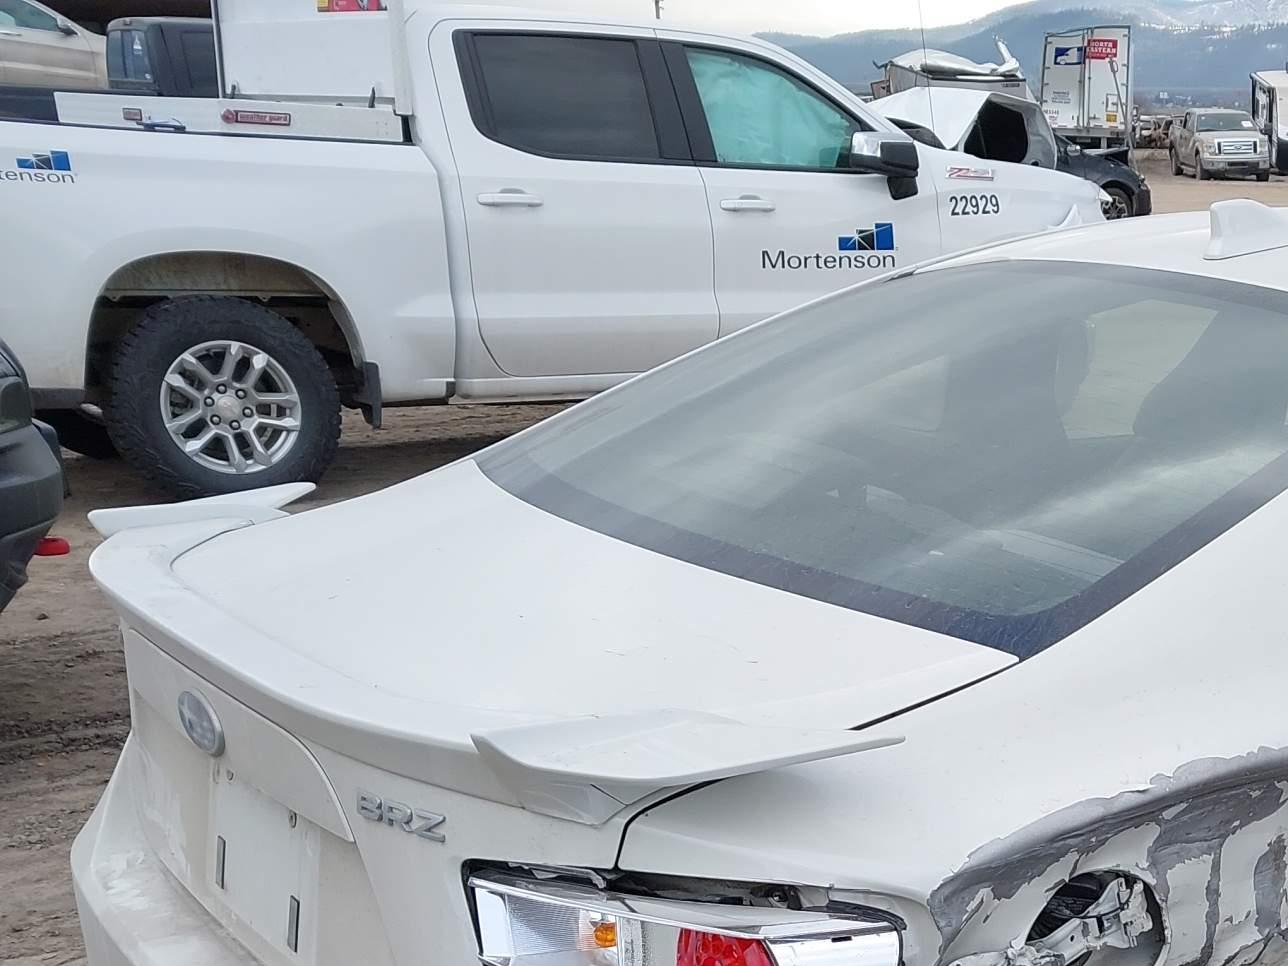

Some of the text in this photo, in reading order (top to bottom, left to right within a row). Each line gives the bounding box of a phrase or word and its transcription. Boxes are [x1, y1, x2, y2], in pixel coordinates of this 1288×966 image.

[949, 194, 1001, 217] 22929
[761, 249, 896, 269] Mortenson
[357, 791, 447, 843] BRZ
